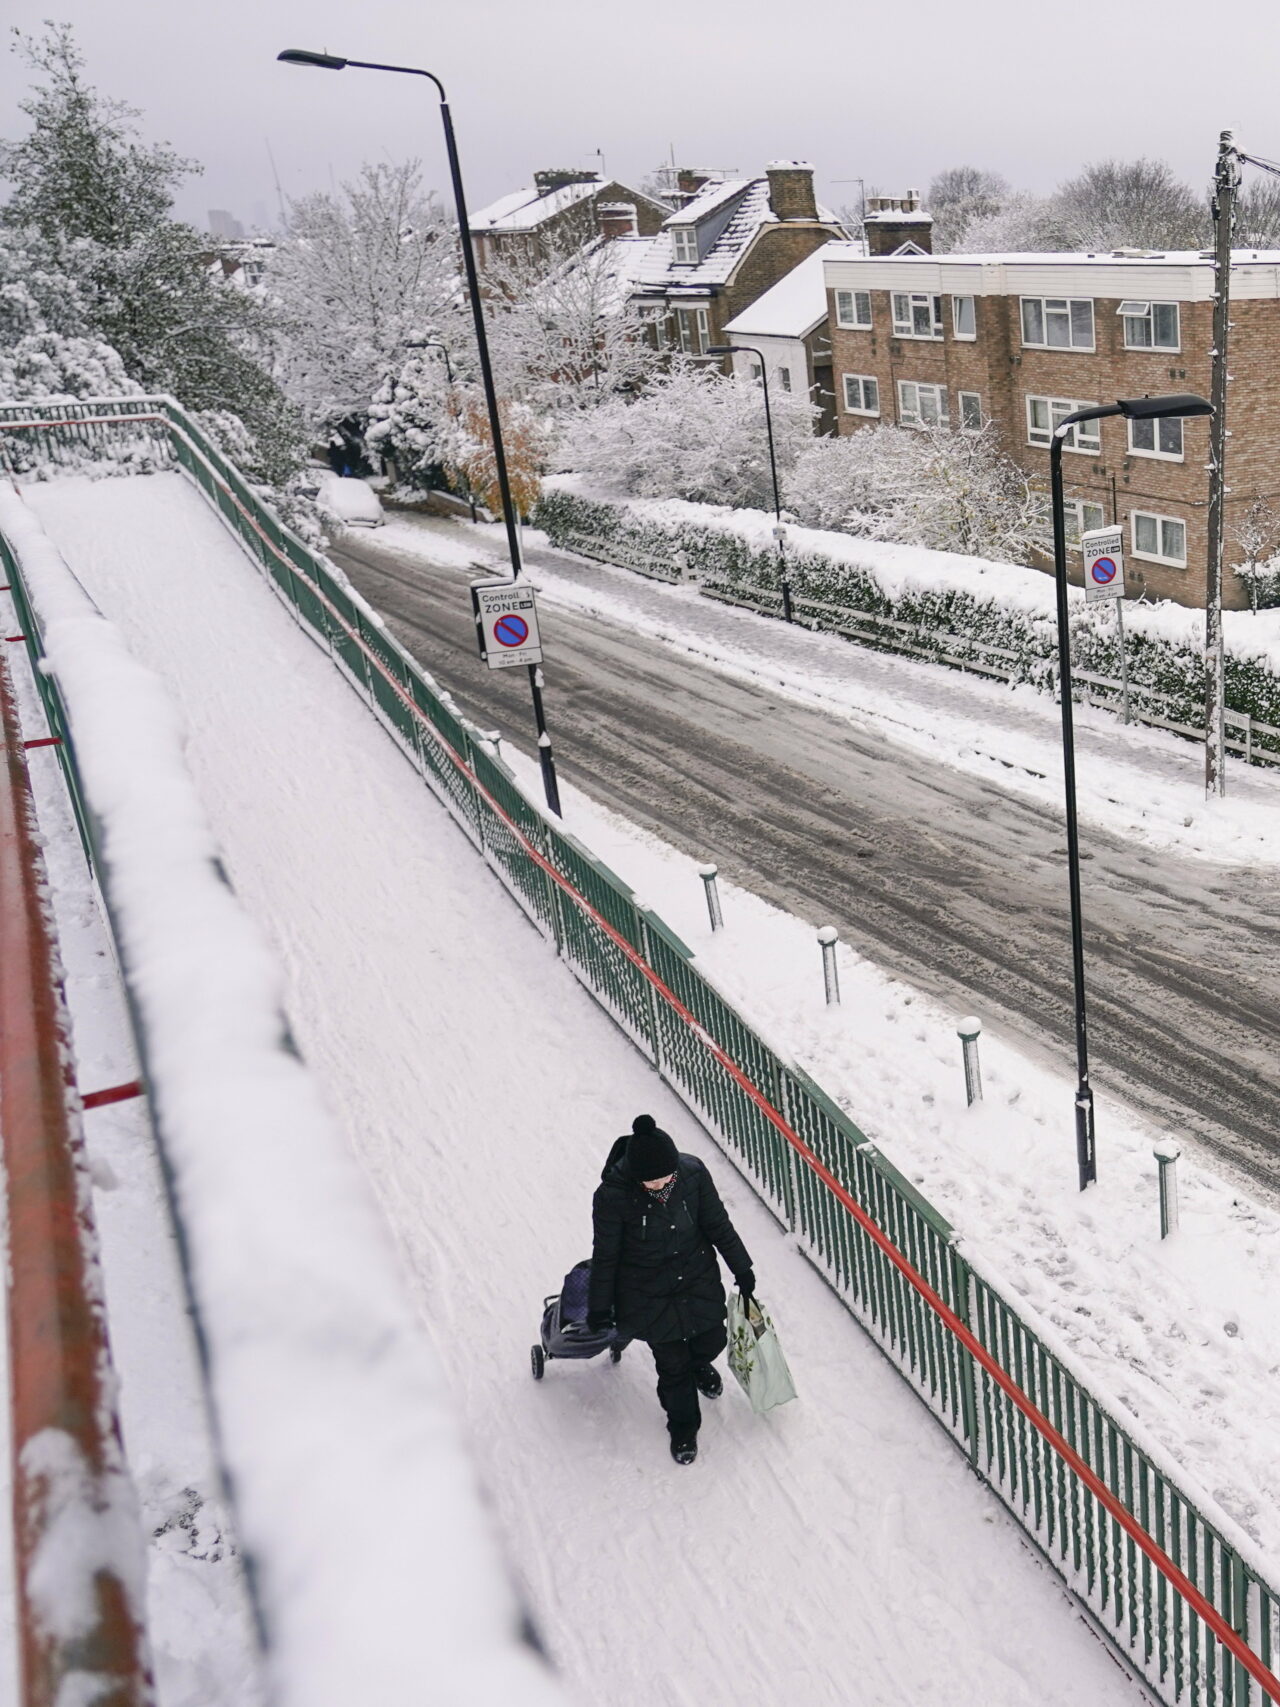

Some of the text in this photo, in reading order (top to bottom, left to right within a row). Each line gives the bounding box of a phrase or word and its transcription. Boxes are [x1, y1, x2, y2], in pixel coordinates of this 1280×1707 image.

[1085, 538, 1119, 548] Controlled
[1086, 547, 1110, 557] ZONE
[482, 592, 530, 602] Controll
[484, 601, 519, 614] ZONE
